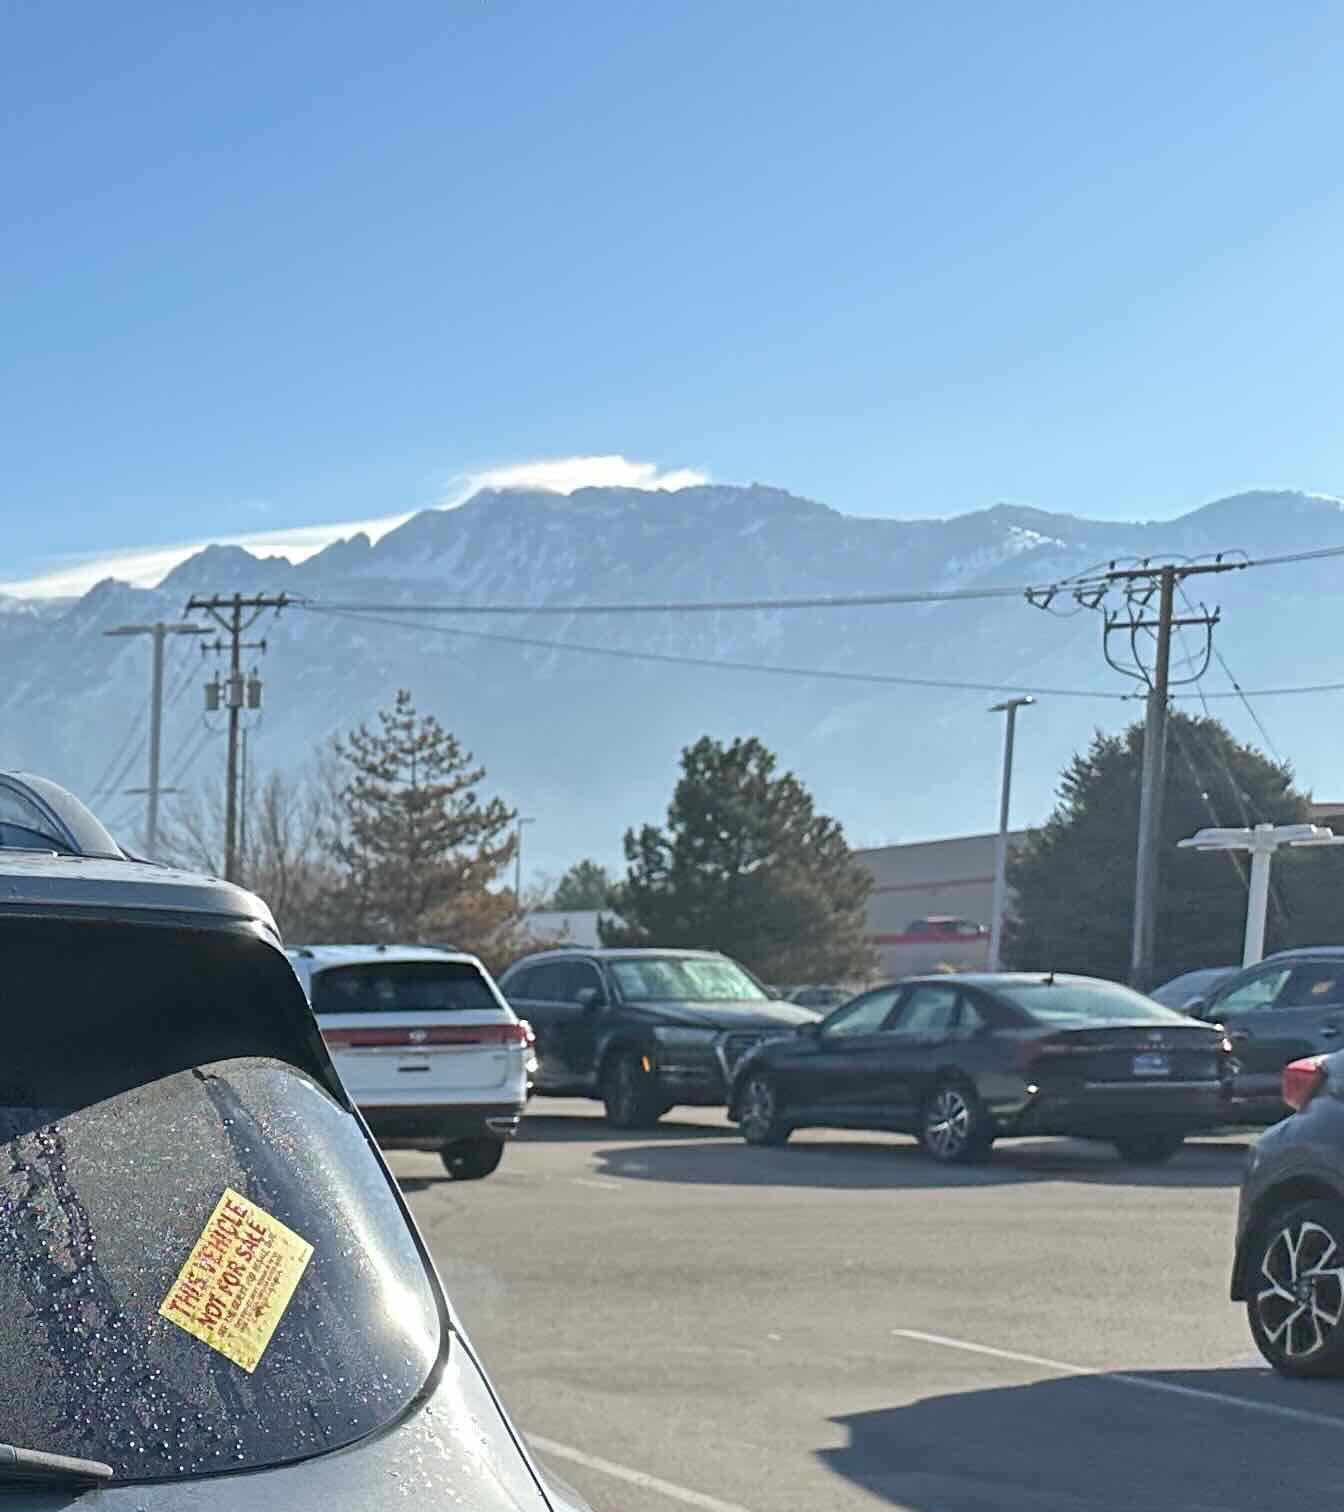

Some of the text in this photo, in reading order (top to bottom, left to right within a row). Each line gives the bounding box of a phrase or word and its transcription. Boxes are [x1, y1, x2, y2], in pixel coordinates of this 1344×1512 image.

[168, 1271, 207, 1317] THIS
[193, 1199, 248, 1274] VEHICLE
[197, 1292, 227, 1331] NOT
[217, 1261, 246, 1296] FOR
[235, 1219, 267, 1262] SALE
